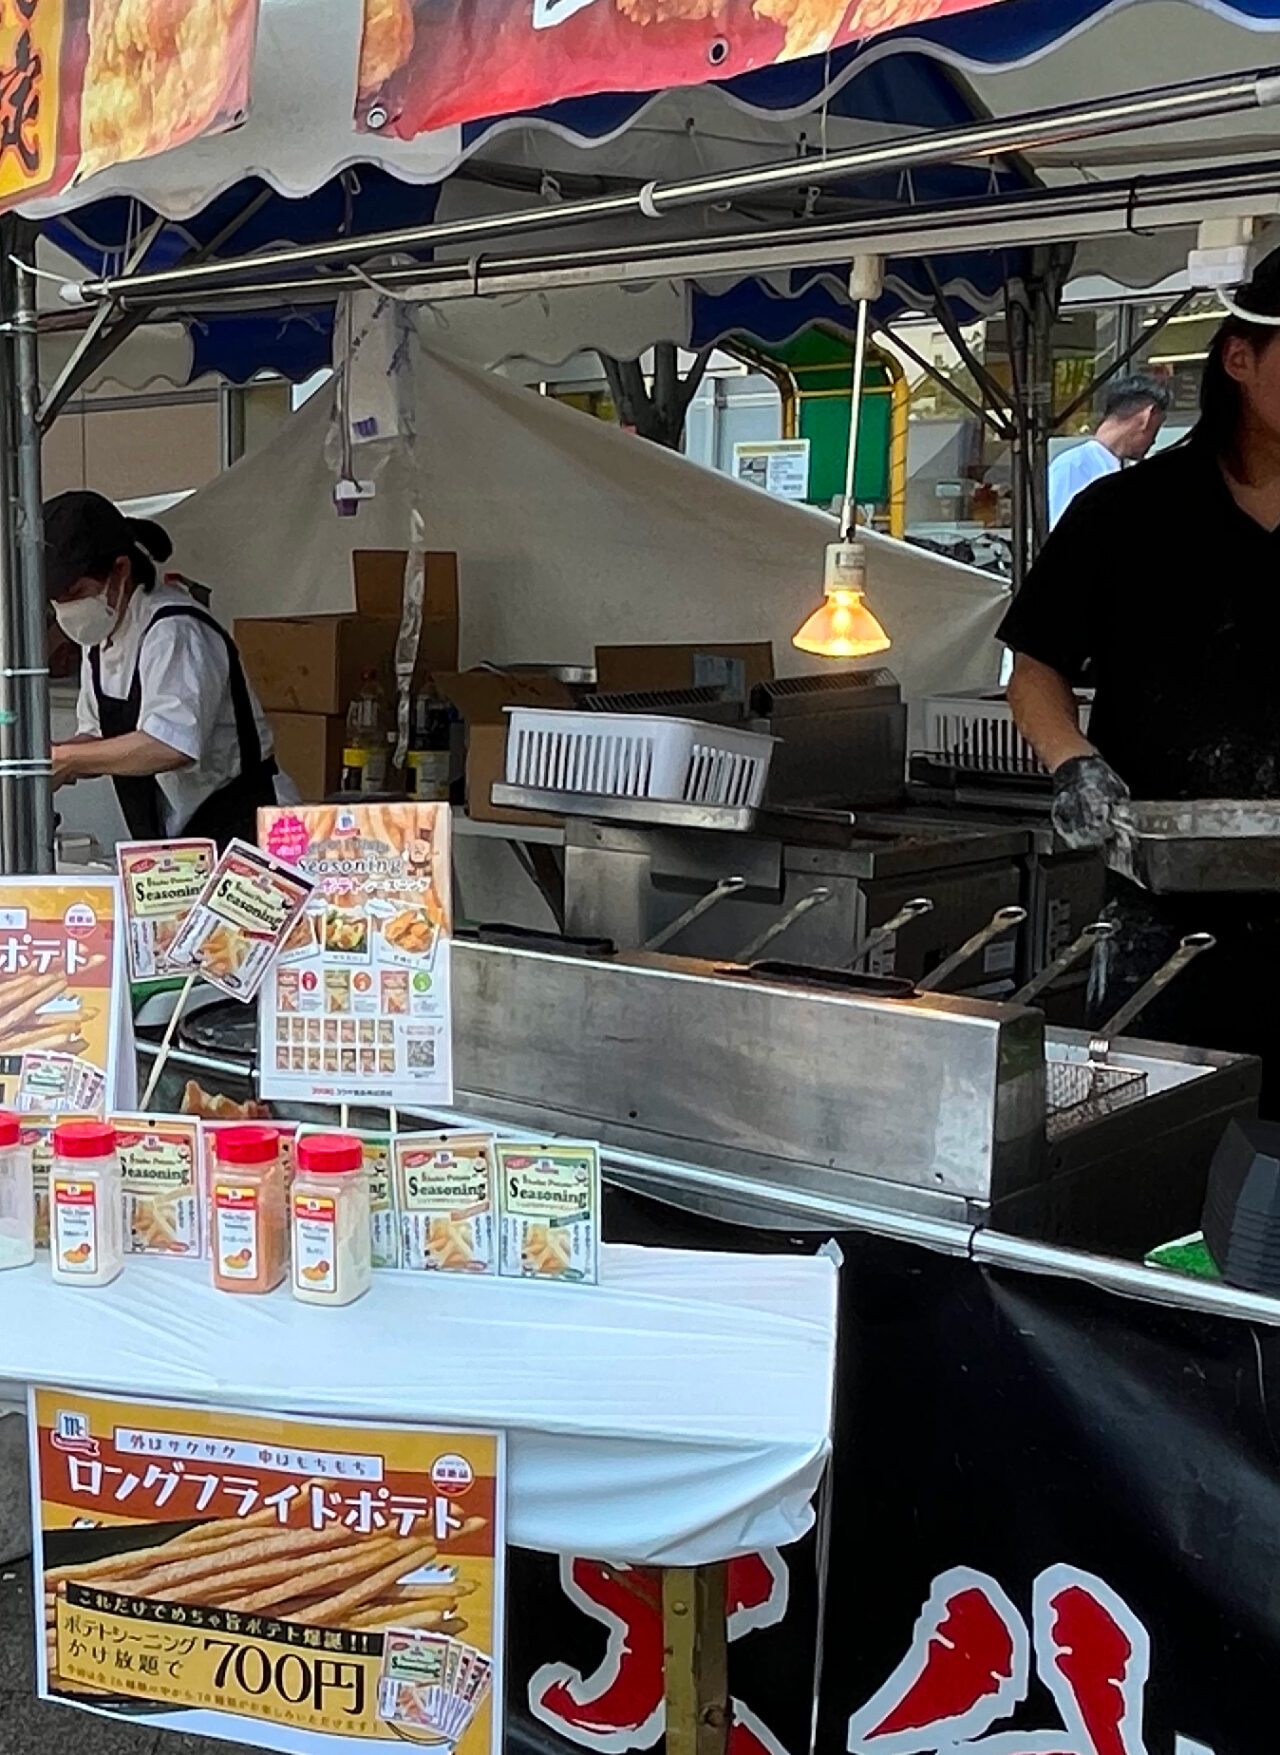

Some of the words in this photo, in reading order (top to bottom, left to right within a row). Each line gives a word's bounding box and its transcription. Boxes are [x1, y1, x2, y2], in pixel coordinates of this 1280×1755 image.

[408, 1176, 486, 1200] Seasoning
[509, 1177, 587, 1208] Seasoning
[129, 1433, 236, 1459] 外はサクサク
[258, 1449, 367, 1475] 中はもちもち
[67, 1455, 463, 1540] ロングフライドポテト
[68, 1638, 184, 1680] かけ放題で
[203, 1638, 365, 1715] 700円
